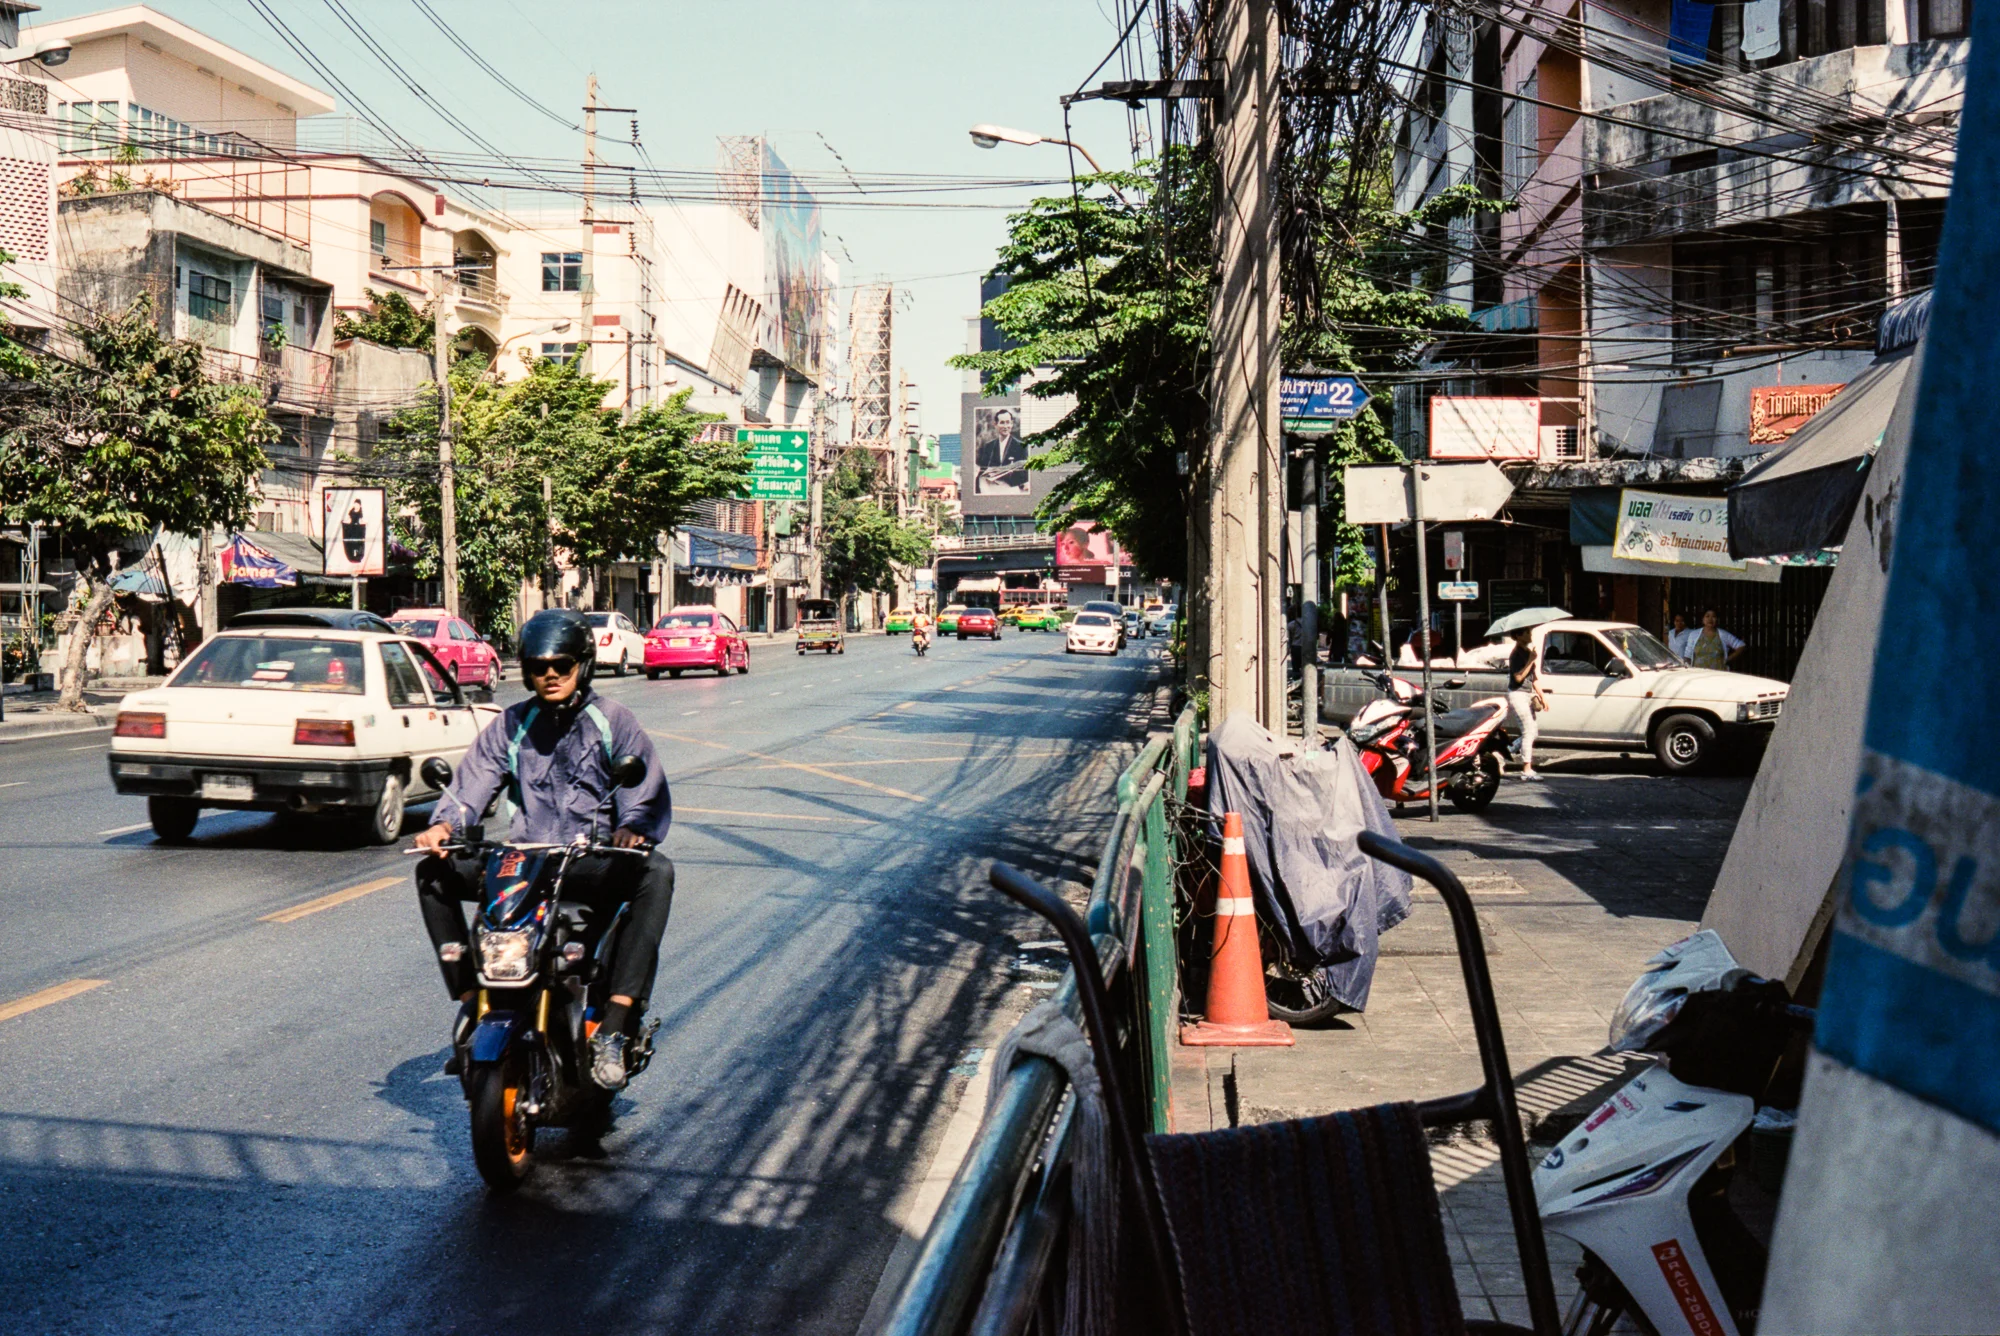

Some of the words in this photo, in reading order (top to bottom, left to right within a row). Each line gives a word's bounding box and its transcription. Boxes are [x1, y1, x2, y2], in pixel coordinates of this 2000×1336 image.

[1329, 382, 1353, 405] 22
[1660, 532, 1728, 553] อะไหล่แต่งมอไ
